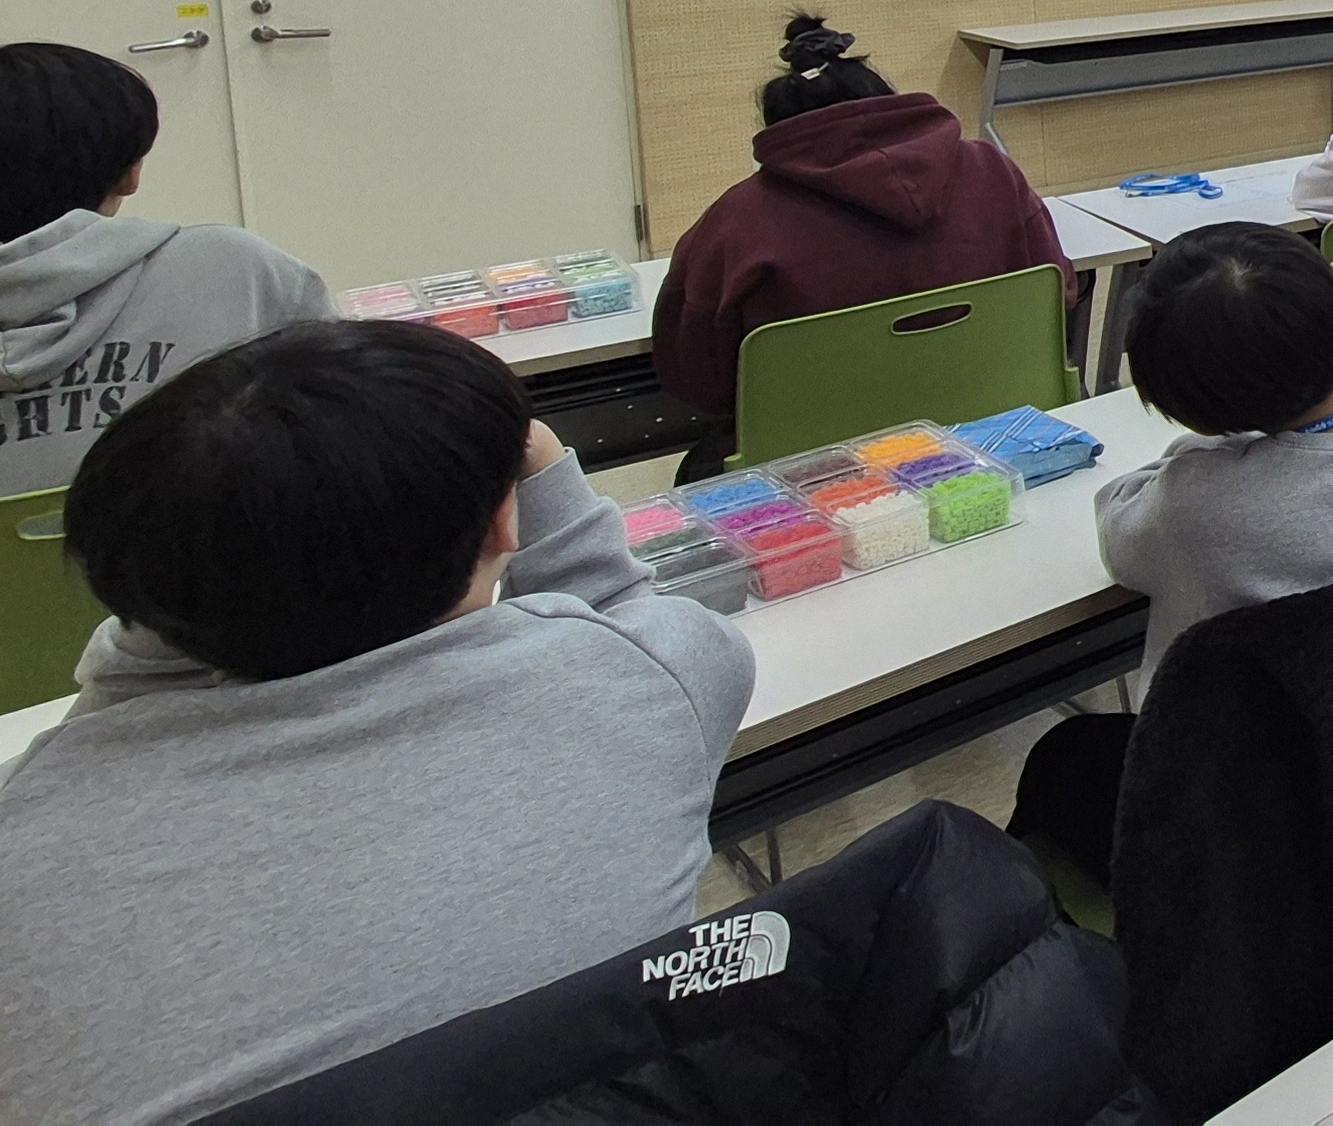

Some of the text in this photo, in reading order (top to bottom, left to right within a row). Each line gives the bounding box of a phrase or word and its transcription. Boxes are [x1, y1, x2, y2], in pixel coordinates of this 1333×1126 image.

[38, 340, 176, 390] ERN
[0, 385, 127, 448] HTS
[688, 914, 752, 947] THE
[642, 937, 747, 983] NORTH
[668, 961, 742, 1001] FACE
